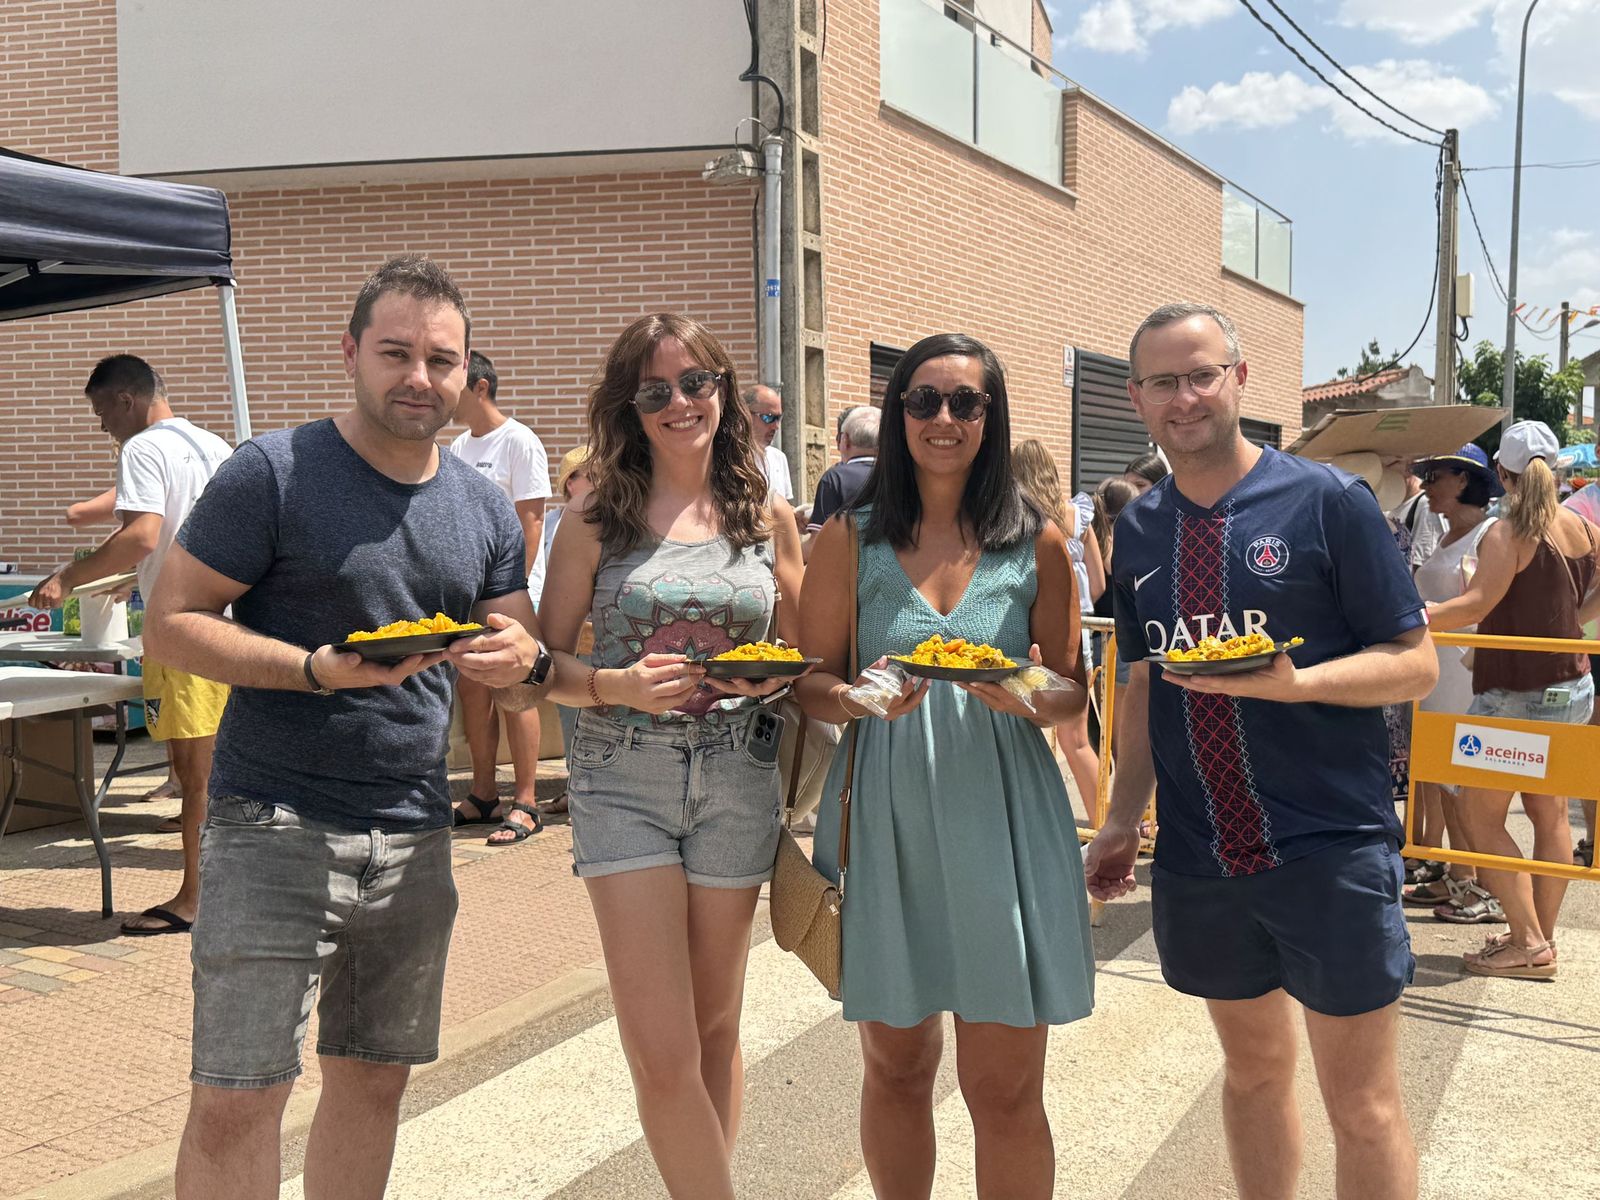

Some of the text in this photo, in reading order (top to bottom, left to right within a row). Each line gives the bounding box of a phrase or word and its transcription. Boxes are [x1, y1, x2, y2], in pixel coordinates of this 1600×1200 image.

[1253, 538, 1281, 548] PARIS
[1145, 609, 1274, 656] QATAR
[1485, 746, 1545, 764] aceinsa
